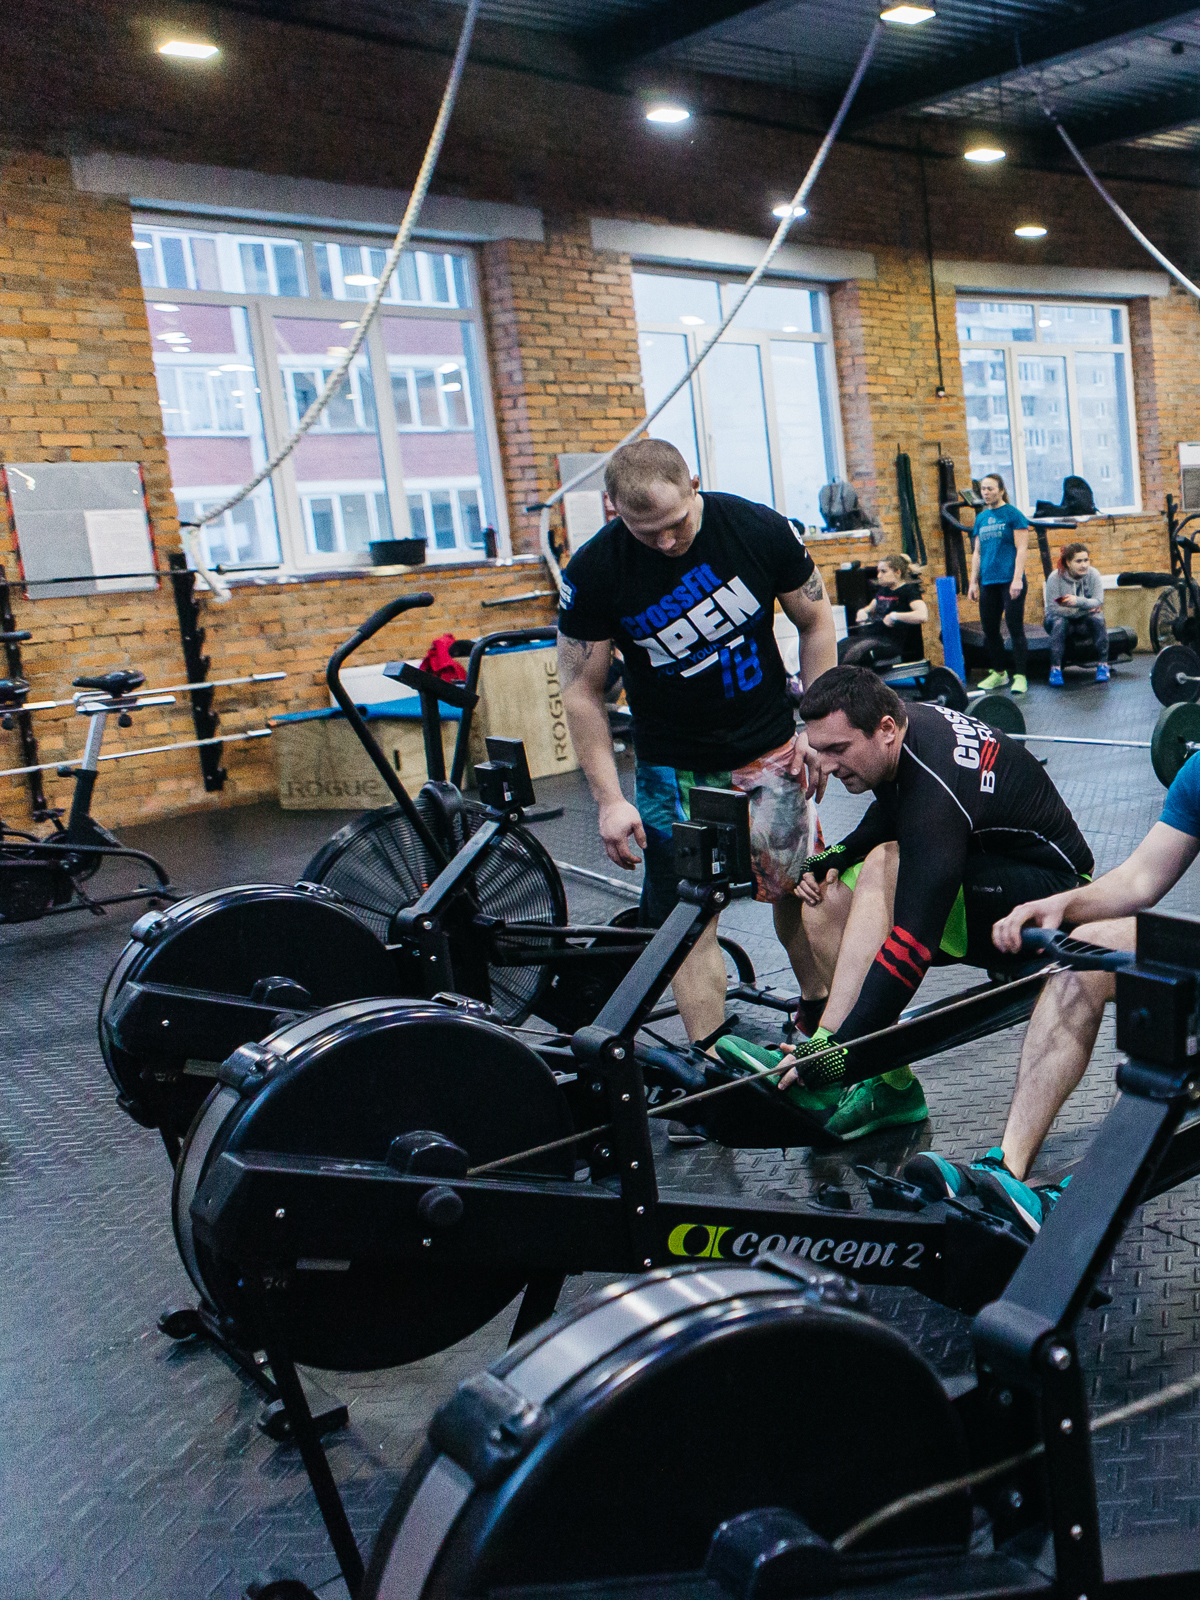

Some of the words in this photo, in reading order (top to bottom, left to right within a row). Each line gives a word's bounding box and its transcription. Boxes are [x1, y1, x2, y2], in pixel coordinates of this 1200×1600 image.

[620, 563, 722, 638] CrossFit
[544, 662, 568, 762] ROGUE
[286, 780, 382, 798] ROGUE
[732, 1232, 898, 1269] concept
[902, 1243, 925, 1268] 2
